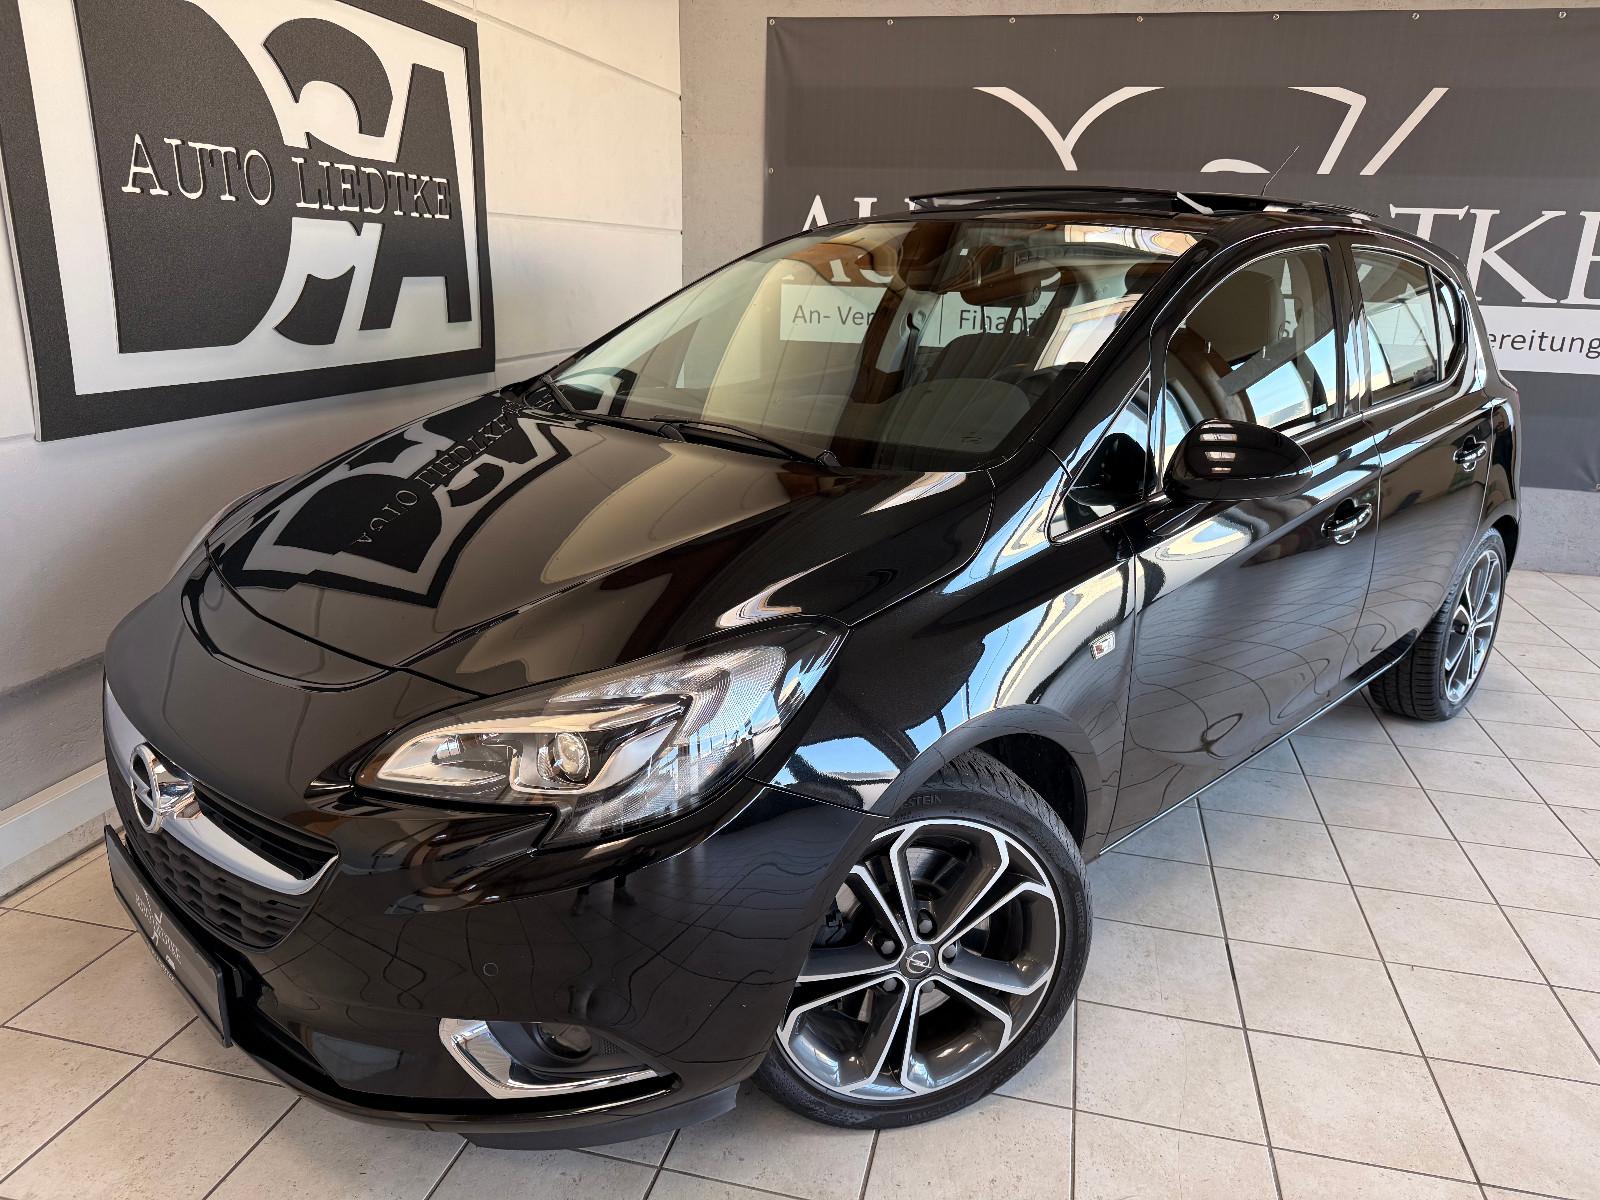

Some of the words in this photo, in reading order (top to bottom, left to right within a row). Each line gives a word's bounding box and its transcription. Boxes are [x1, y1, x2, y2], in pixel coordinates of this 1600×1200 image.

[121, 133, 273, 206] AUTO
[291, 155, 452, 220] LIEDTKE
[837, 305, 876, 326] Ver
[1488, 329, 1600, 360] reitung
[902, 793, 943, 808] STEIN
